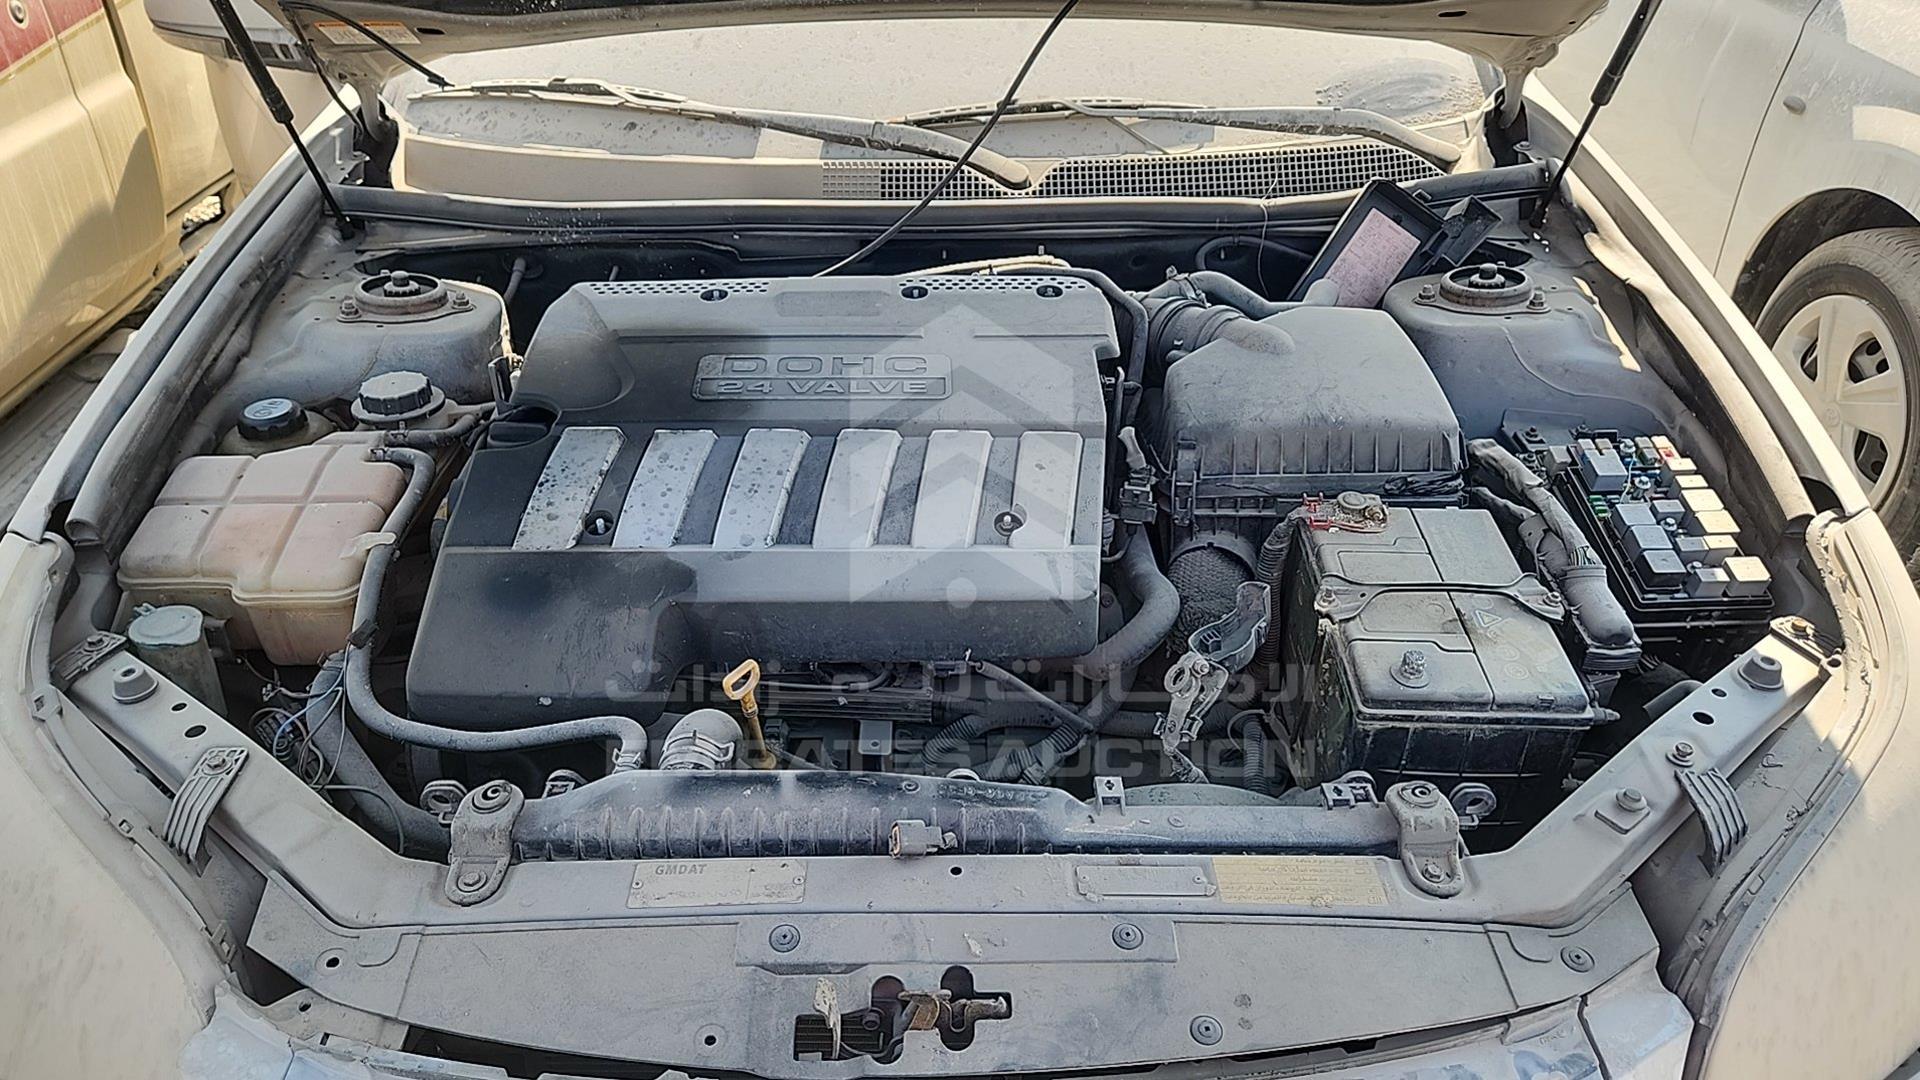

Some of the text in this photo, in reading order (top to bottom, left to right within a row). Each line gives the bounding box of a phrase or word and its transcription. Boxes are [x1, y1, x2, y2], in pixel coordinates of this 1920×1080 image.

[721, 356, 928, 376] DOHC
[717, 379, 928, 394] 24 VALVE
[655, 864, 707, 876] GMDAT
